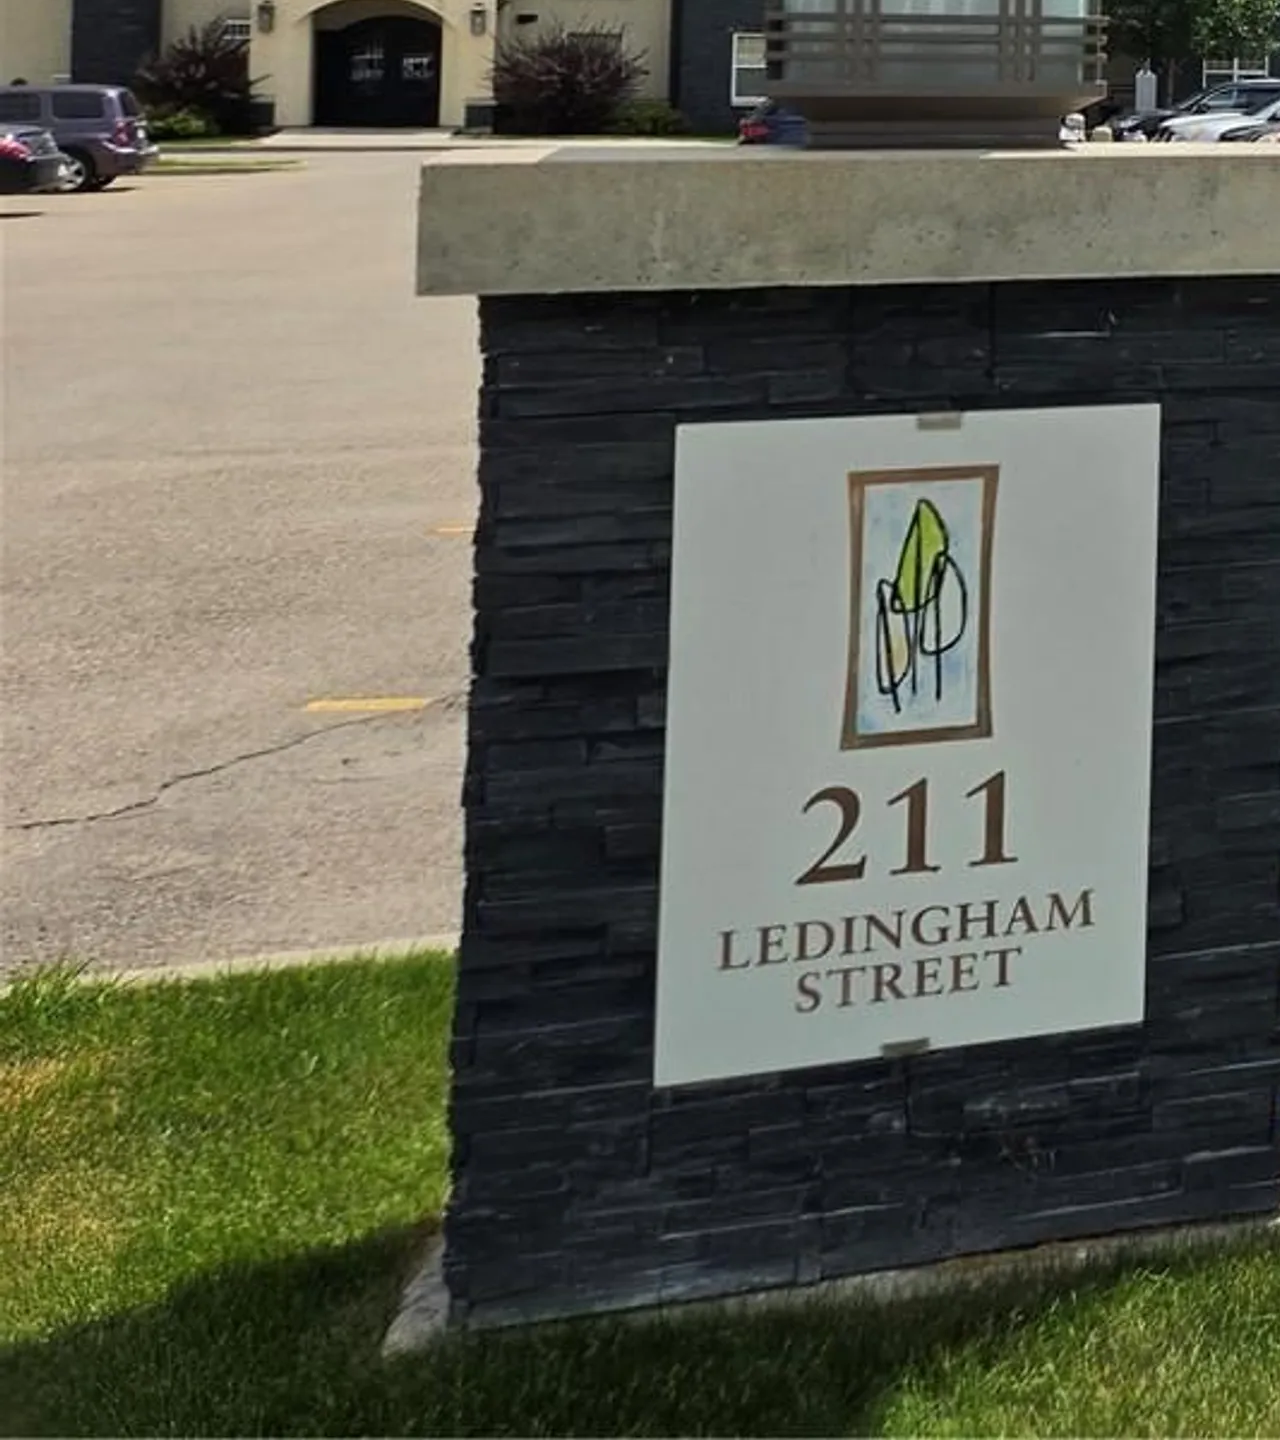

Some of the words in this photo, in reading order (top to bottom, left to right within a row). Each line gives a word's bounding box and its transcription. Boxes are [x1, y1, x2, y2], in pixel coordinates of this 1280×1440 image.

[795, 769, 1019, 886] 211
[717, 889, 1096, 970] LEDINGHAM
[795, 947, 1022, 1013] STREET
